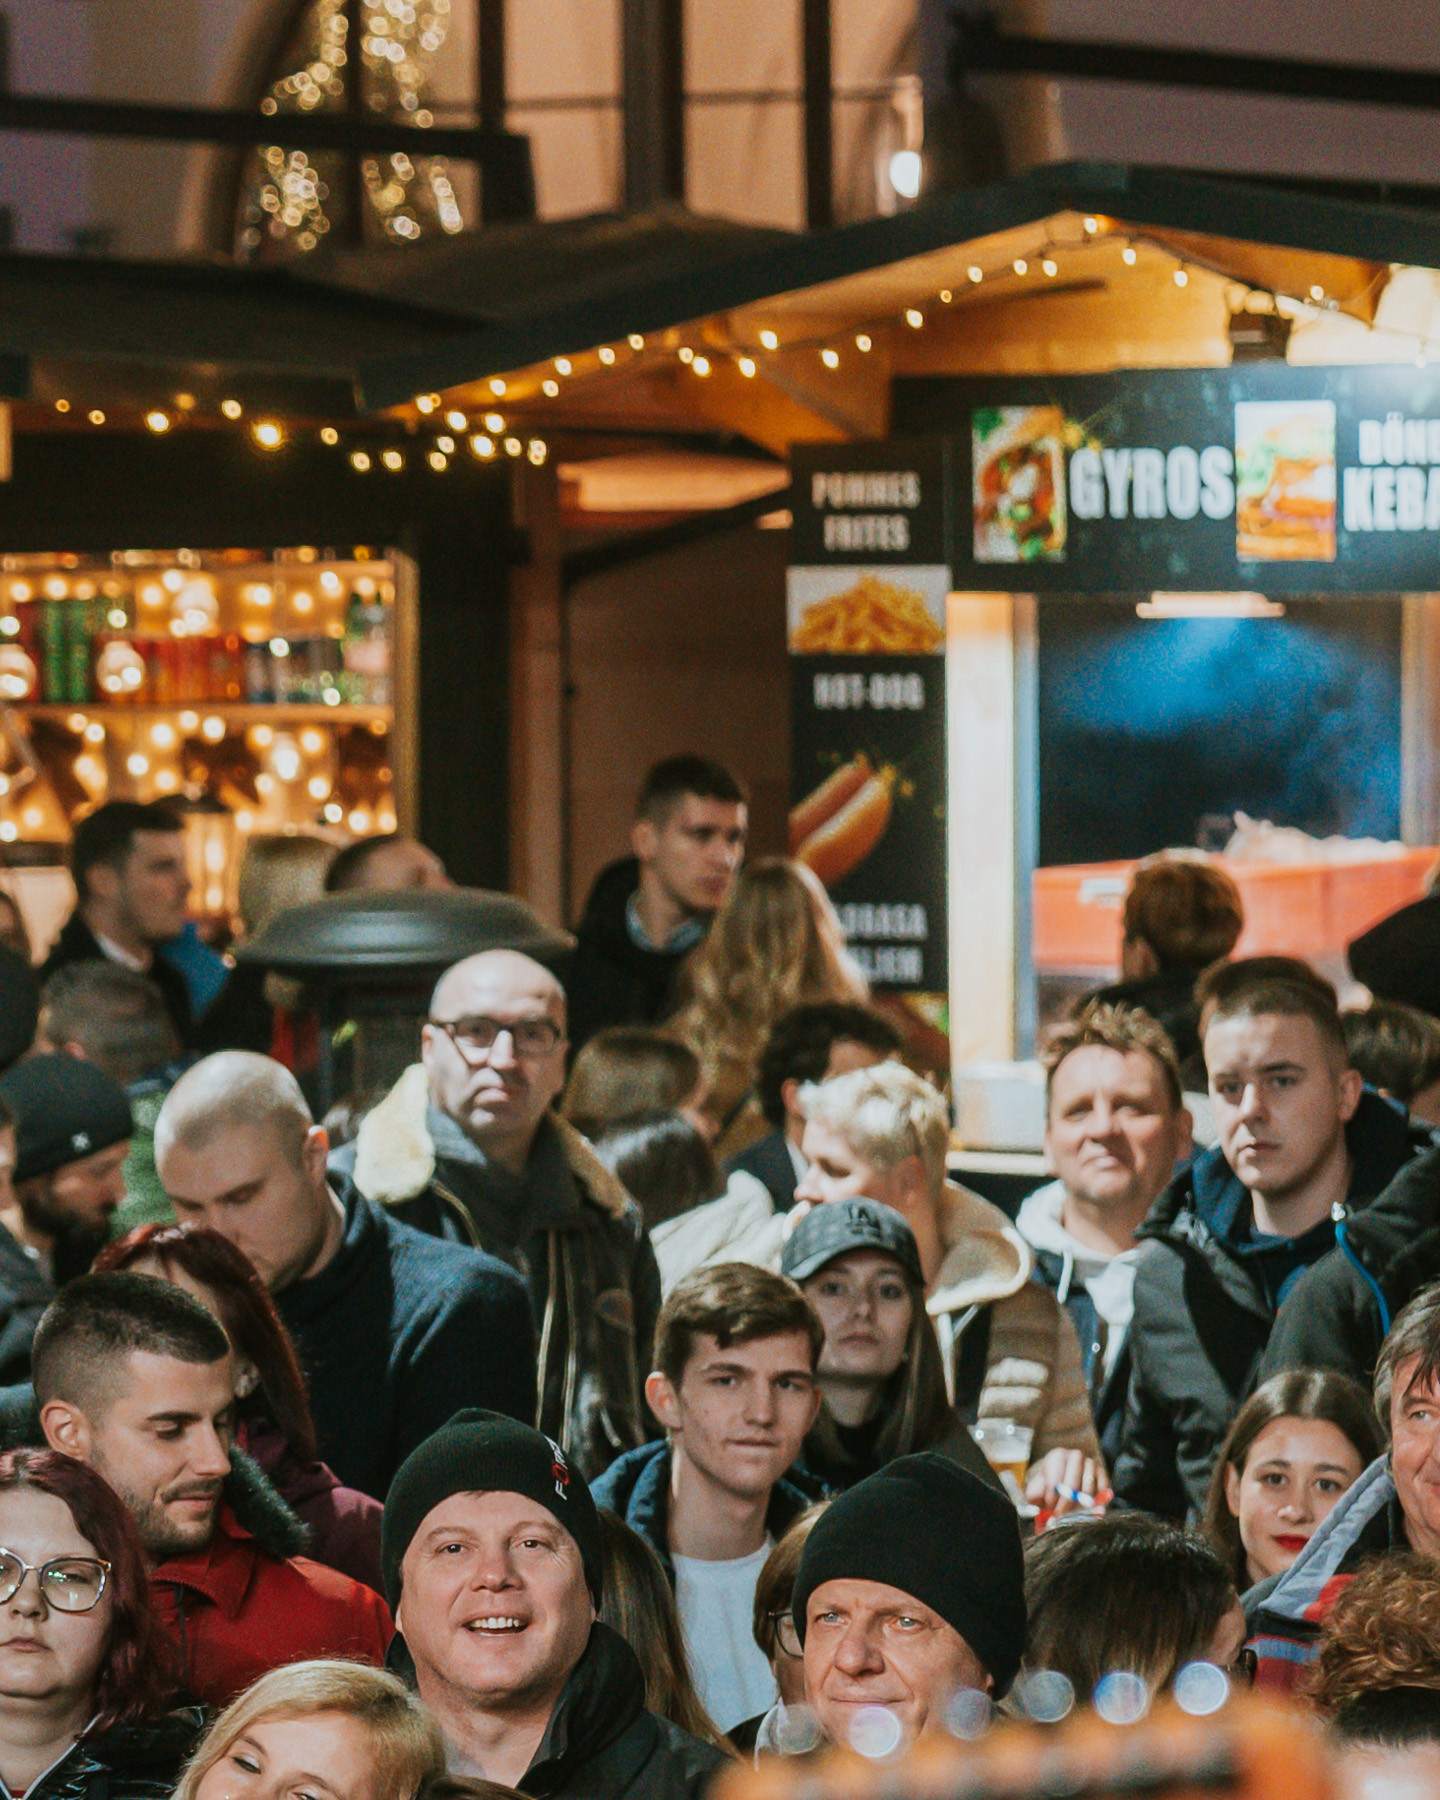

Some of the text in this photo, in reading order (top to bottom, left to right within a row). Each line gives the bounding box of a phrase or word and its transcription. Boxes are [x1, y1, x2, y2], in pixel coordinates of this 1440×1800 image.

[811, 471, 921, 509] POMMES
[1069, 445, 1235, 520] GYROS
[823, 515, 910, 551] FRITES
[813, 672, 925, 710] HOT-DOG
